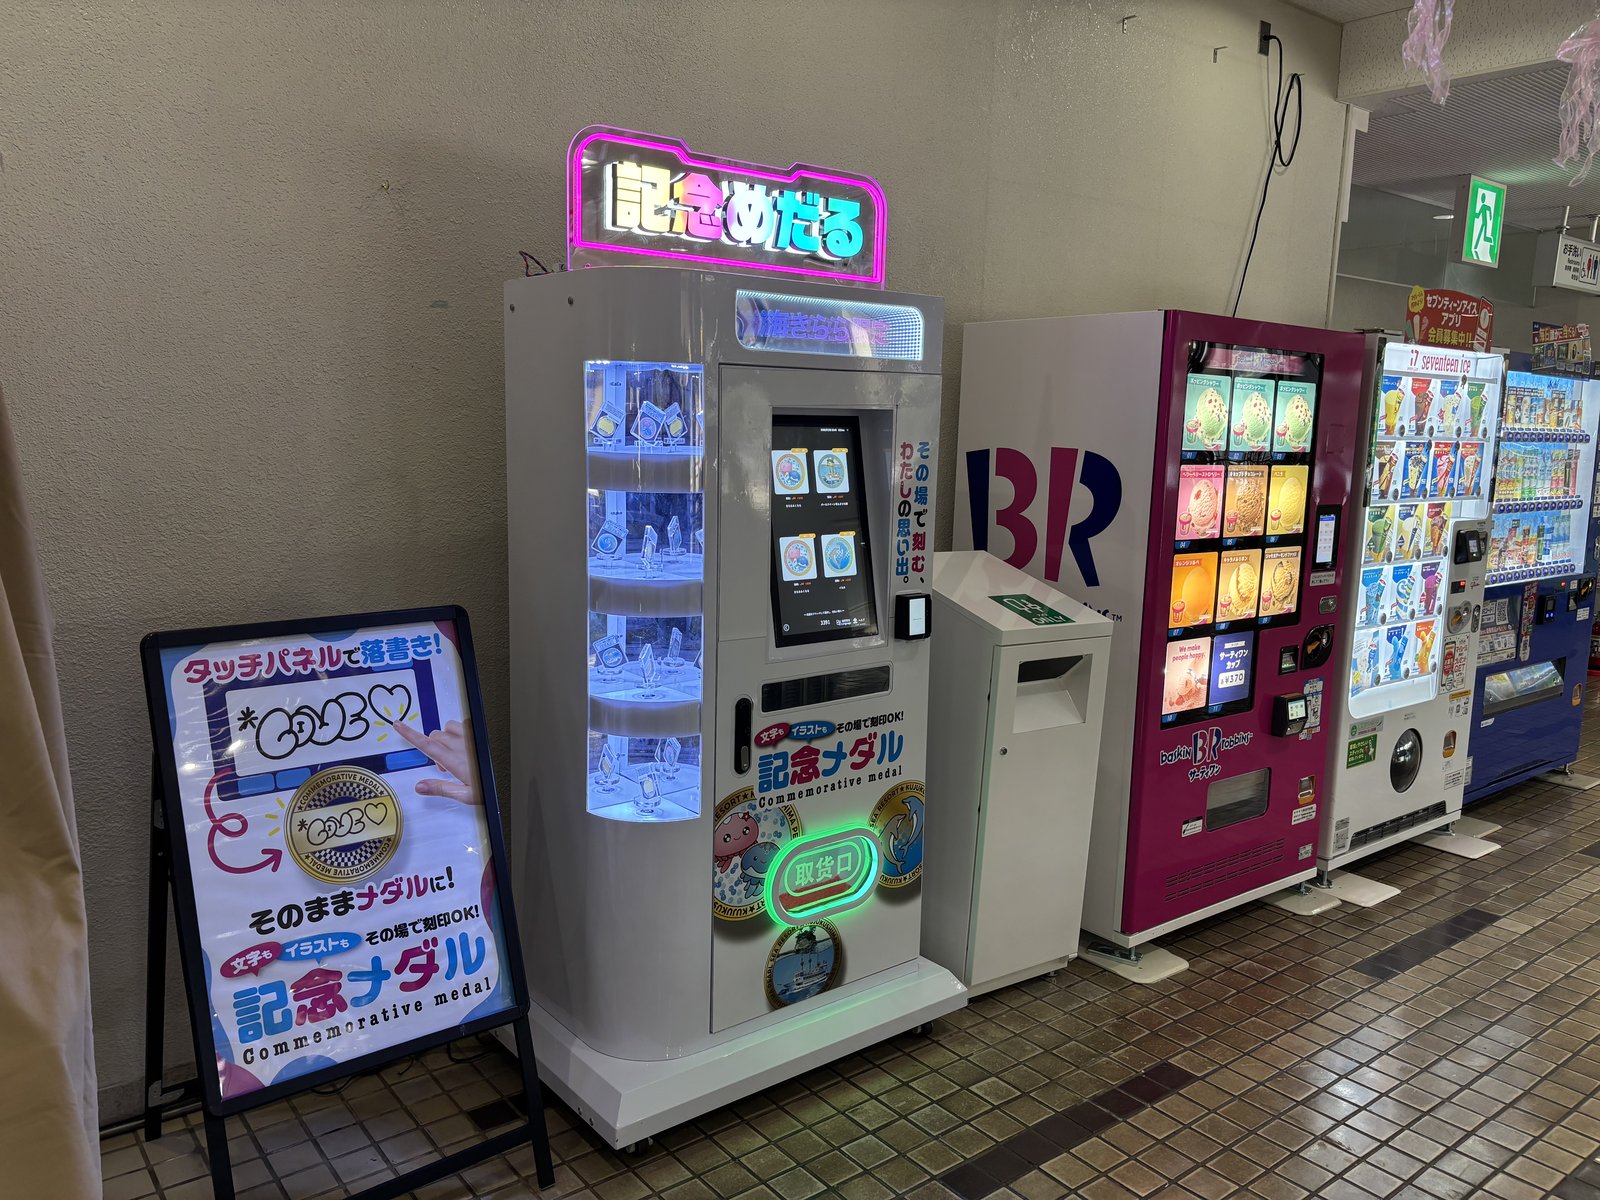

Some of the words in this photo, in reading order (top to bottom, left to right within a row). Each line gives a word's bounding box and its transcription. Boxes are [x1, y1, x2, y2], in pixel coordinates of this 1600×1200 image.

[604, 161, 864, 261] 記念めだる
[1426, 294, 1478, 315] セブンティーンアイス
[1441, 312, 1462, 327] アプリ
[1421, 354, 1459, 372] seventeen
[1459, 357, 1471, 374] ice
[895, 441, 914, 584] わたしの思い出。
[912, 441, 930, 584] その場で刻む、
[966, 446, 1123, 588] BR
[183, 632, 443, 685] タッチパネルで落書き!
[1172, 654, 1188, 662] people
[1179, 645, 1187, 653] We
[1219, 649, 1249, 661] サーティワン
[1226, 660, 1241, 670] カップ
[760, 726, 785, 744] 文字も
[791, 724, 828, 736] イラストも
[836, 711, 904, 734] その場で刻印OK!
[758, 730, 904, 793] 記念メダル
[1160, 745, 1193, 765] baskin
[1192, 727, 1222, 765] BR
[1221, 732, 1250, 751] robbins
[300, 773, 357, 805] COMMEMORATIVE
[358, 775, 381, 792] MEDAL
[759, 776, 862, 808] Commemorative
[868, 765, 903, 783] medal
[1189, 764, 1221, 781] サーティワン
[309, 857, 332, 875] MEDAL
[333, 842, 390, 877] COMMEMORATIVE
[795, 851, 852, 887] 取货口
[248, 866, 456, 936] そのままメダルに!
[230, 949, 273, 975] 文字も
[285, 938, 350, 958] イラストも
[365, 904, 480, 946] その場で刻印OK!
[233, 932, 486, 1044] 記念メダル
[242, 1001, 424, 1066] Commemorative
[434, 976, 492, 1007] medal
